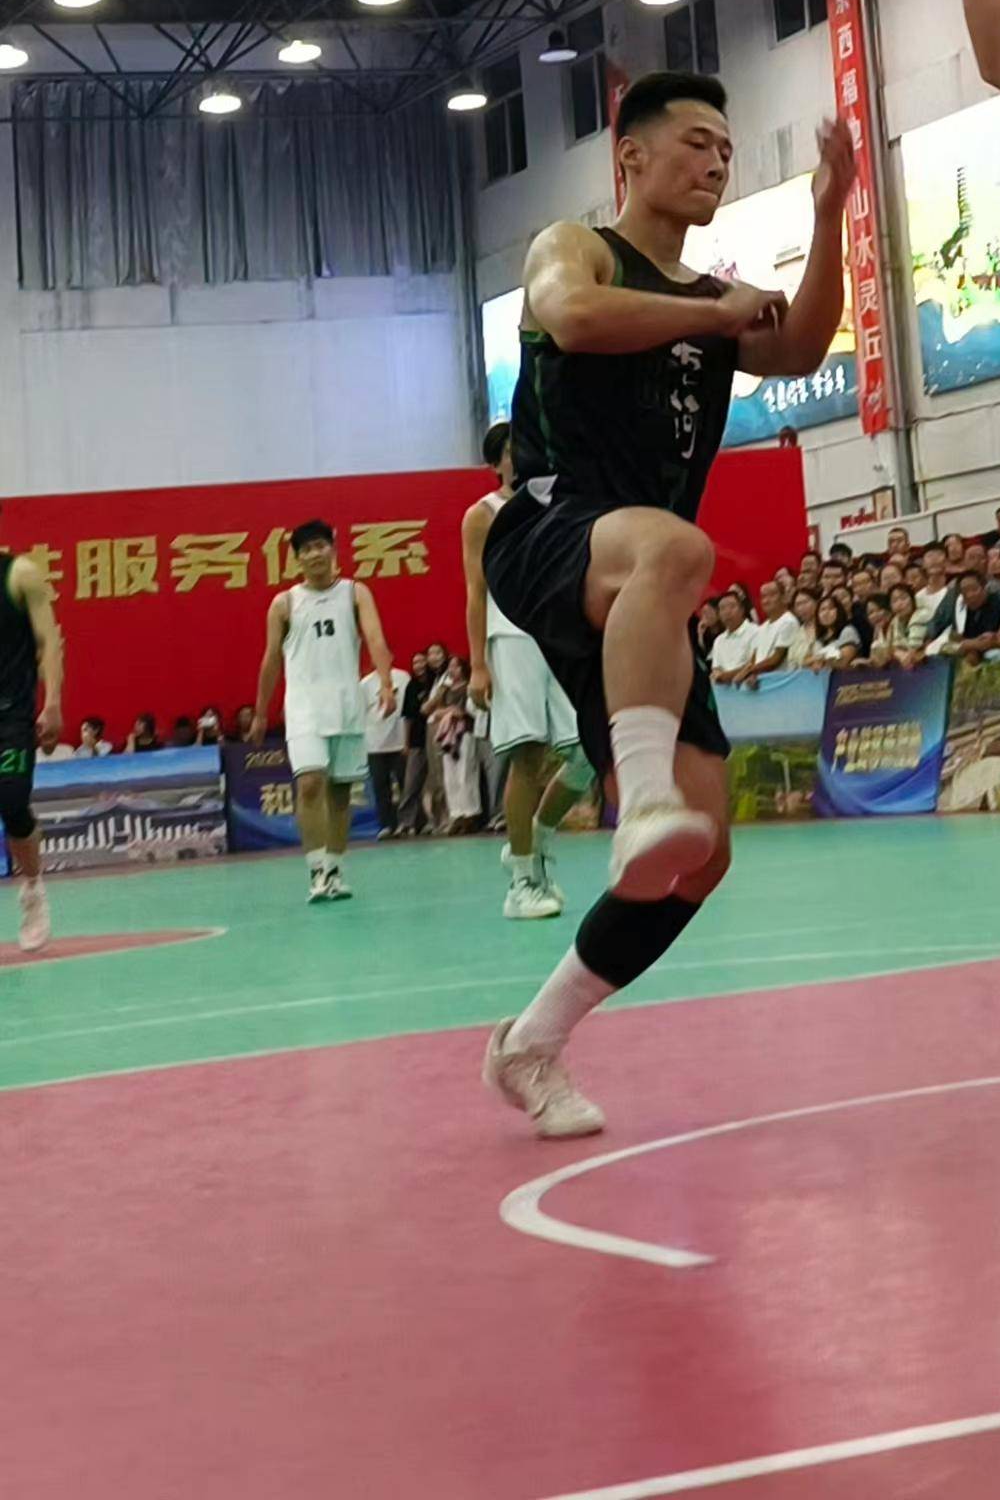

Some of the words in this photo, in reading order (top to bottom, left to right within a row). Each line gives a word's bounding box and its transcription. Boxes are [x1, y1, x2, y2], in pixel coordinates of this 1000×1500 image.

[852, 177, 882, 359] 山水灵丘
[312, 618, 336, 639] 13
